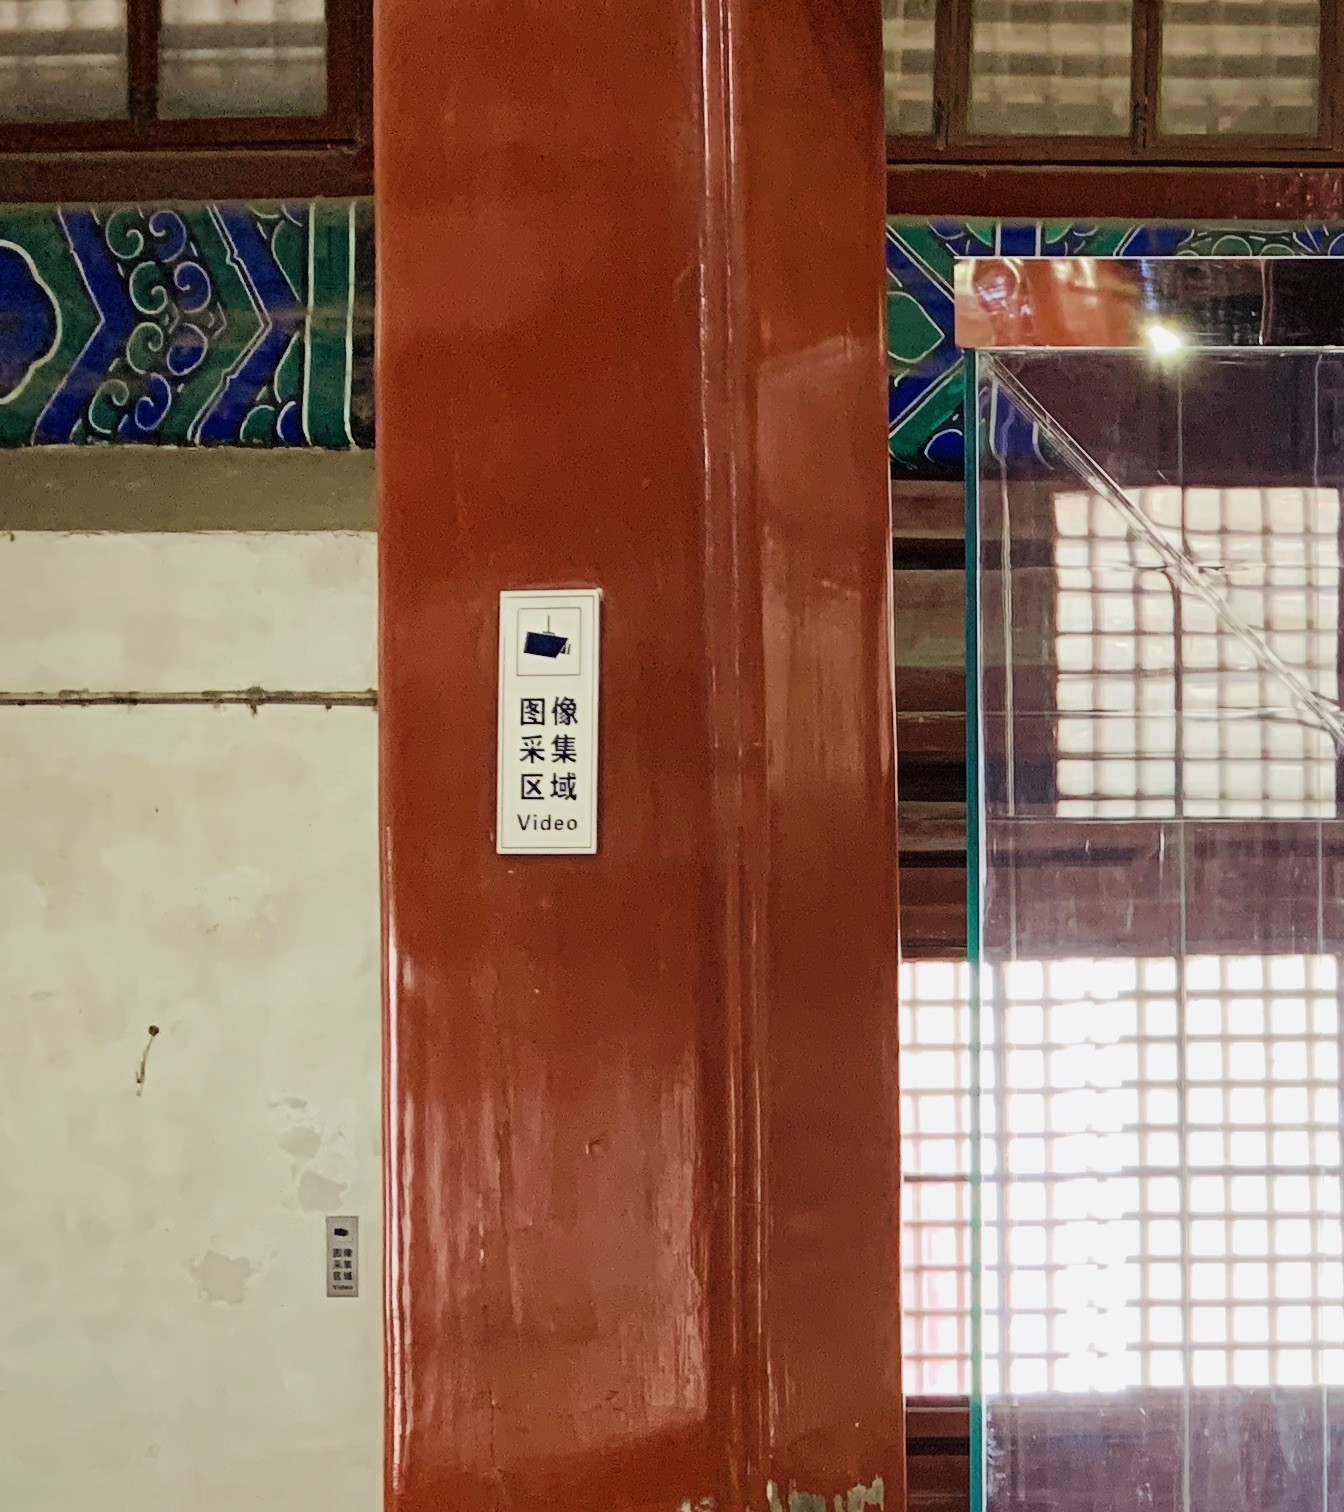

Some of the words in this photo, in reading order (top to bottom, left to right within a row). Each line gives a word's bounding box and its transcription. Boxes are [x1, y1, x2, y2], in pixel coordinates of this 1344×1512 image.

[520, 697, 578, 726] 图像
[519, 734, 577, 763] 采集
[521, 772, 577, 801] 区域
[517, 814, 578, 831] Video
